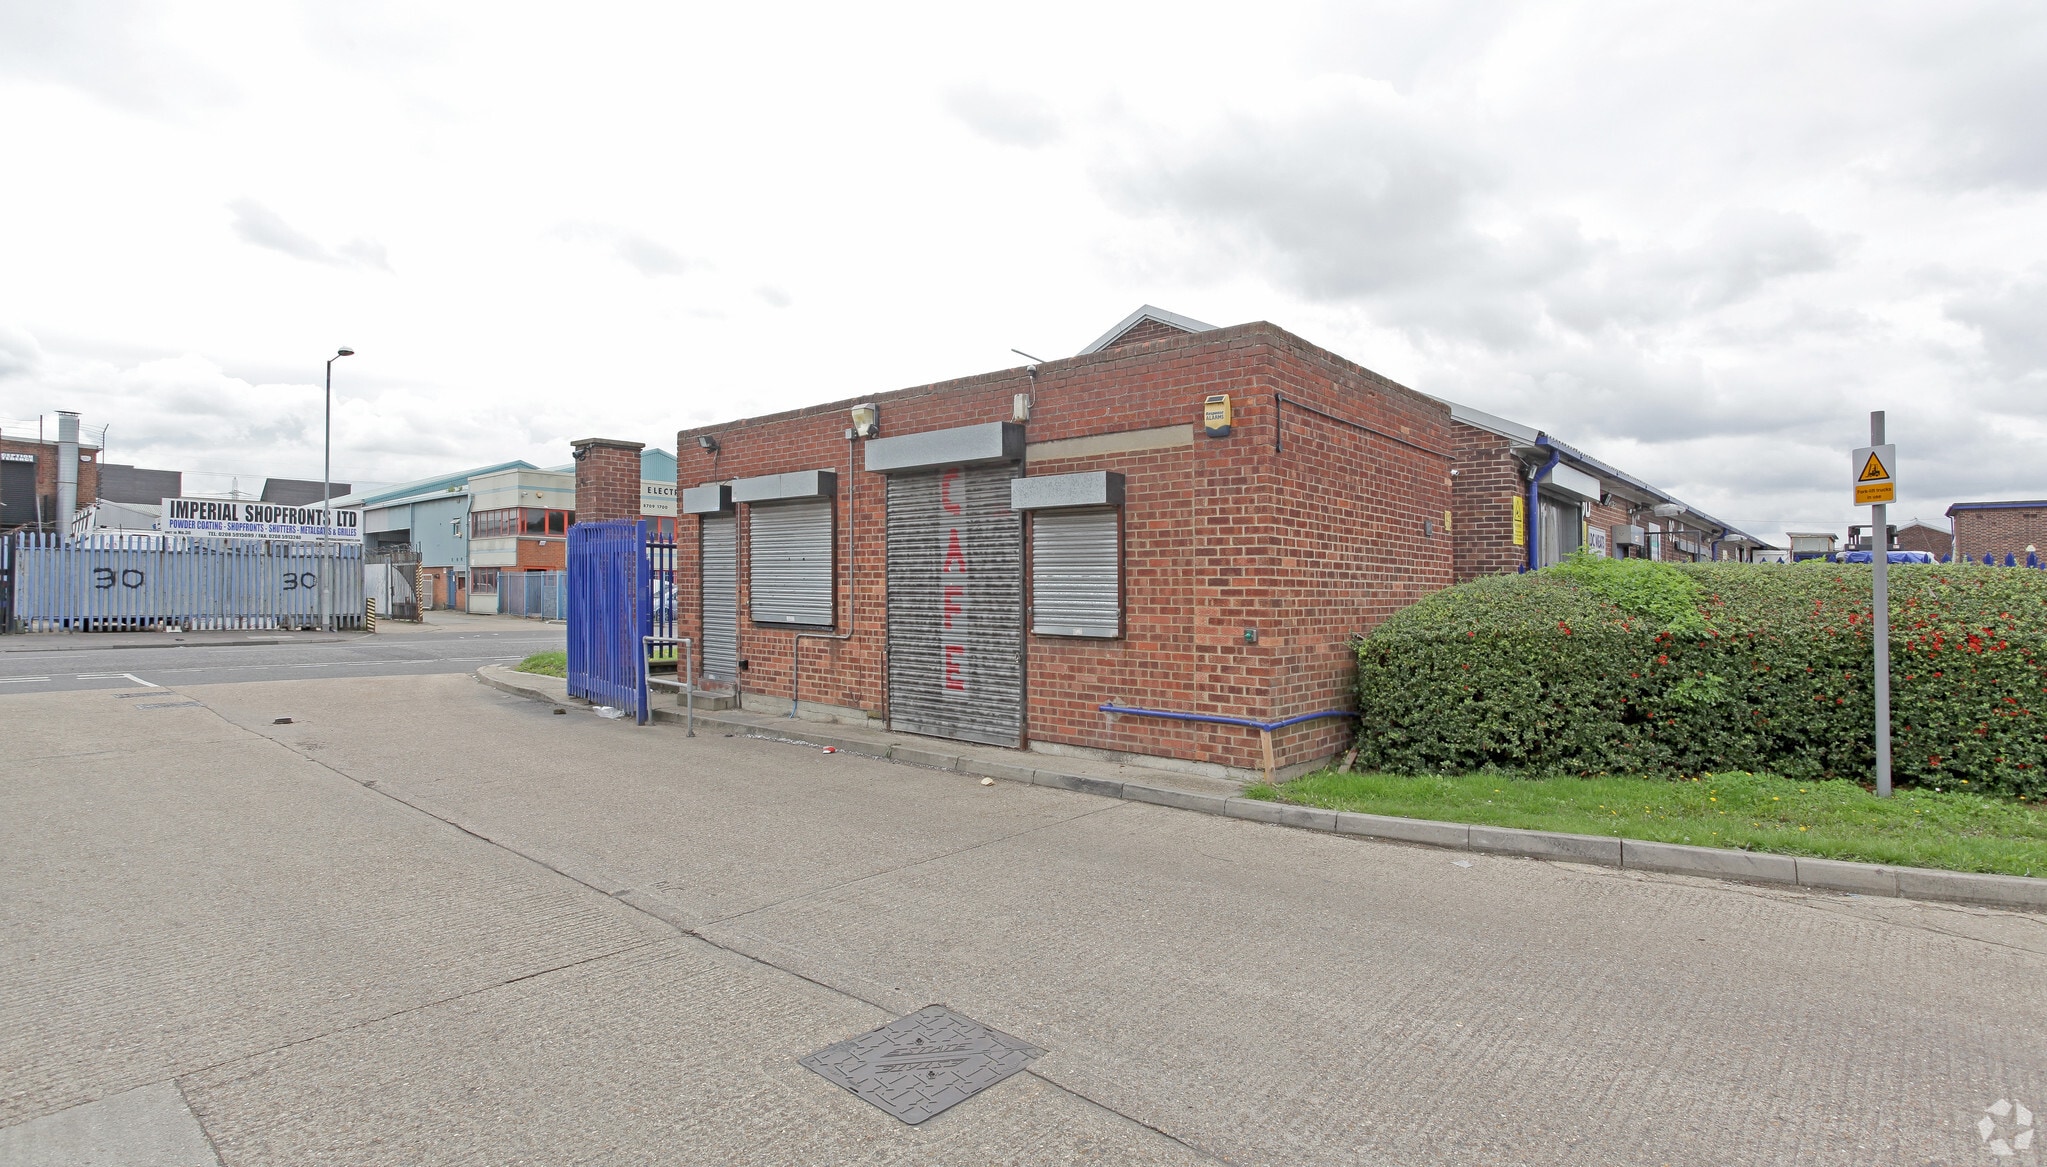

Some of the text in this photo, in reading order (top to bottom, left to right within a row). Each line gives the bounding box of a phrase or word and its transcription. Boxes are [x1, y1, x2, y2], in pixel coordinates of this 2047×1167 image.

[170, 500, 239, 522] IMPERIAL
[337, 510, 357, 528] LTD
[169, 519, 195, 529] POWDER
[197, 520, 223, 531] COATING
[227, 522, 264, 533] SHOPFRONTS
[269, 524, 297, 534] SHUTTERS
[300, 525, 332, 535] METALGATS
[337, 527, 357, 537] GRILLES
[94, 568, 144, 589] 30
[283, 572, 317, 590] 30
[941, 468, 967, 692] CAFE
